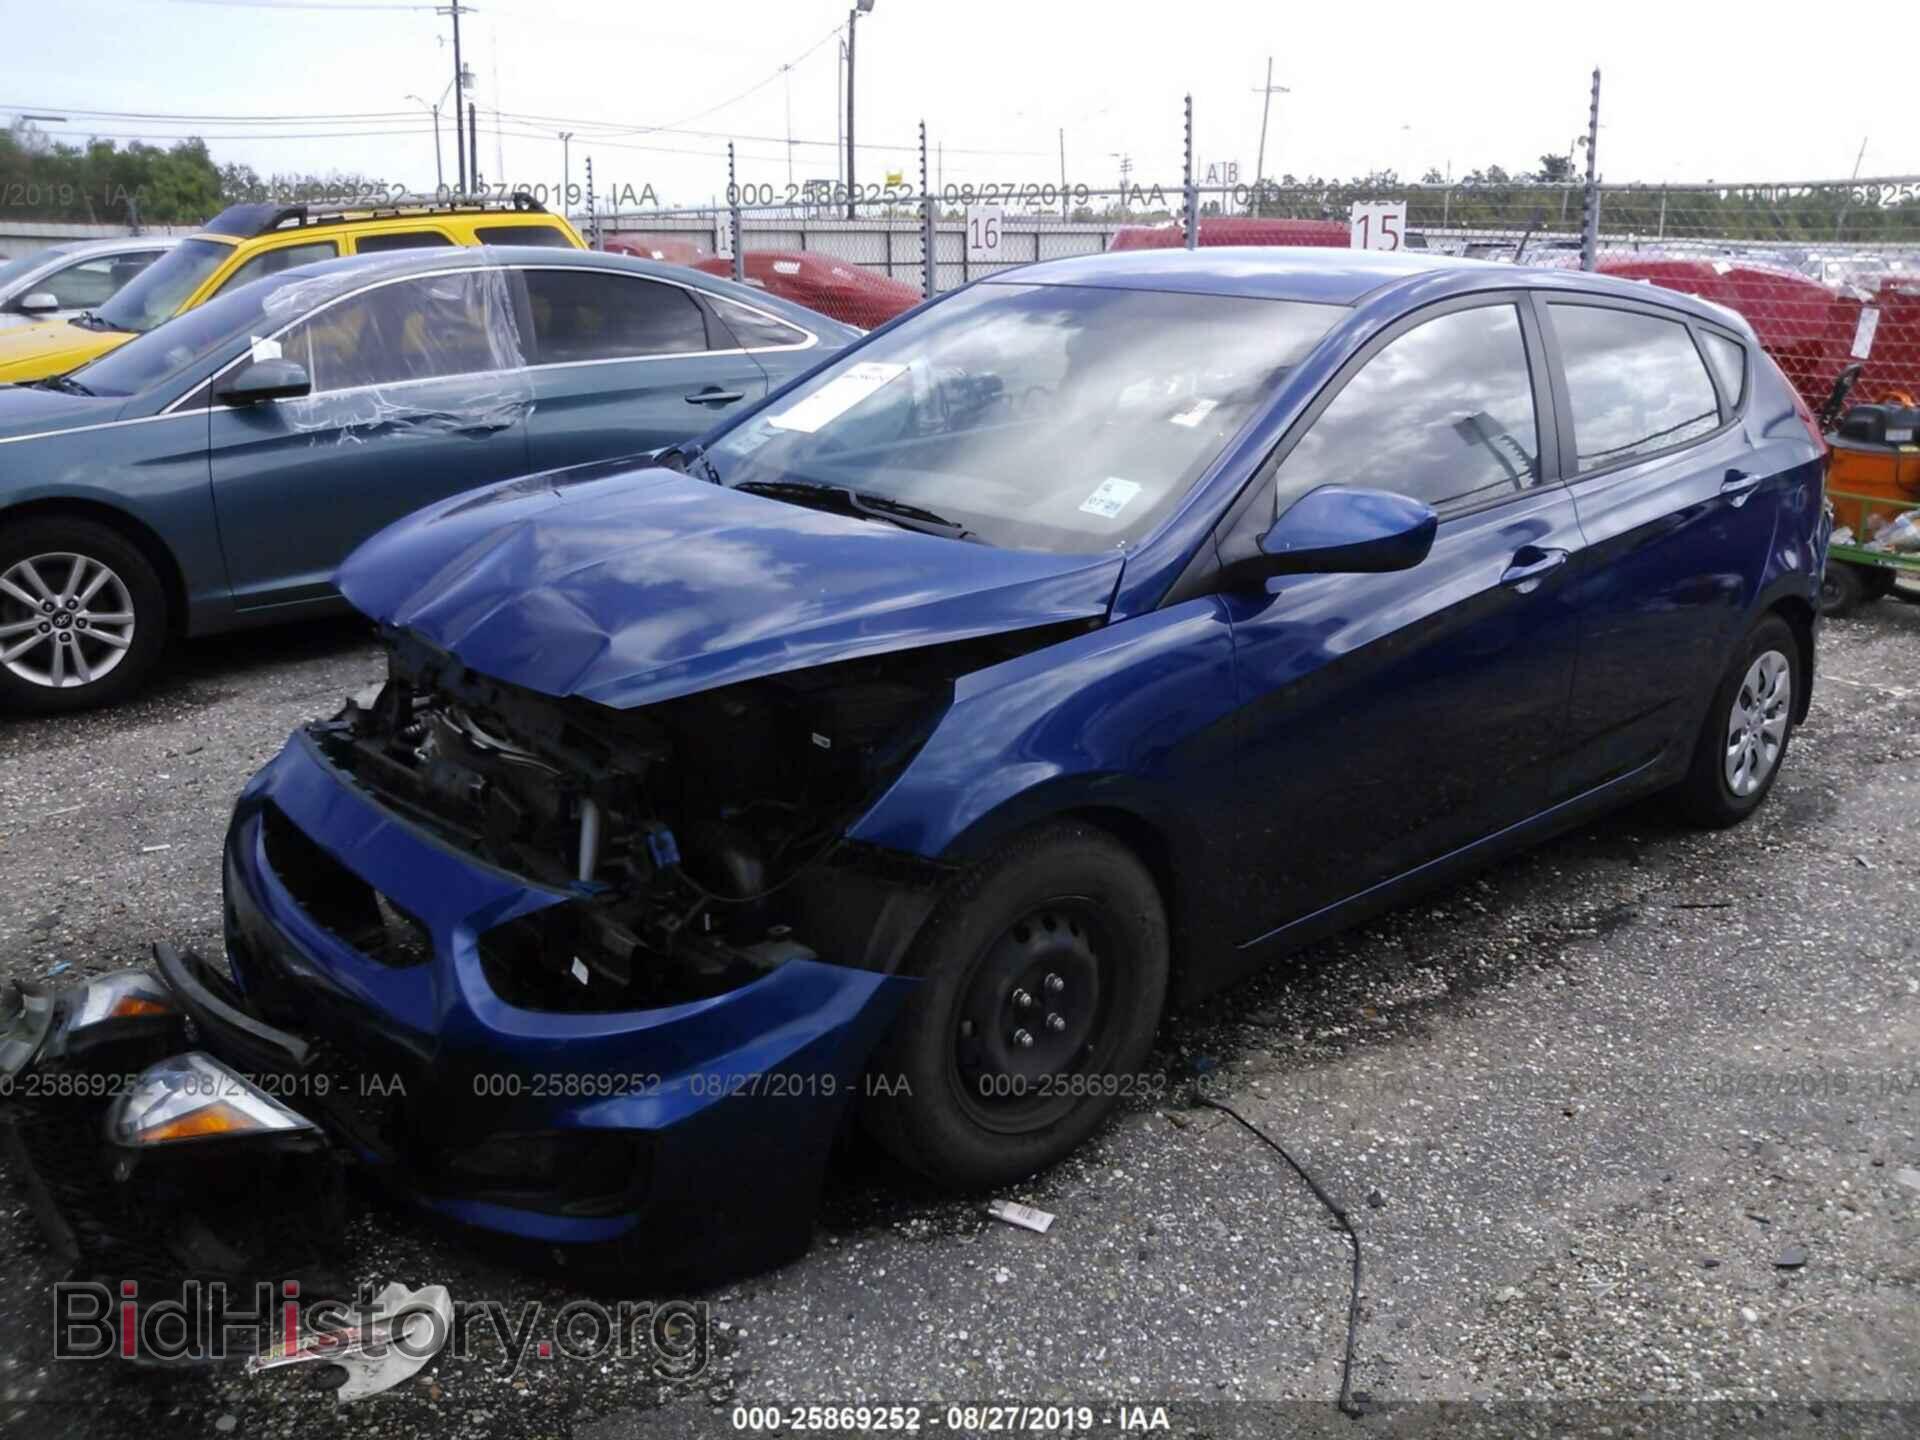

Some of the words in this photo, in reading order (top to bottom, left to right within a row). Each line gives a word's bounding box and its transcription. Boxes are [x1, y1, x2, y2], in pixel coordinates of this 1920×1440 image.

[1206, 163, 1218, 184] A
[1228, 162, 1238, 183] B
[970, 217, 998, 250] 16
[1357, 214, 1399, 252] 15
